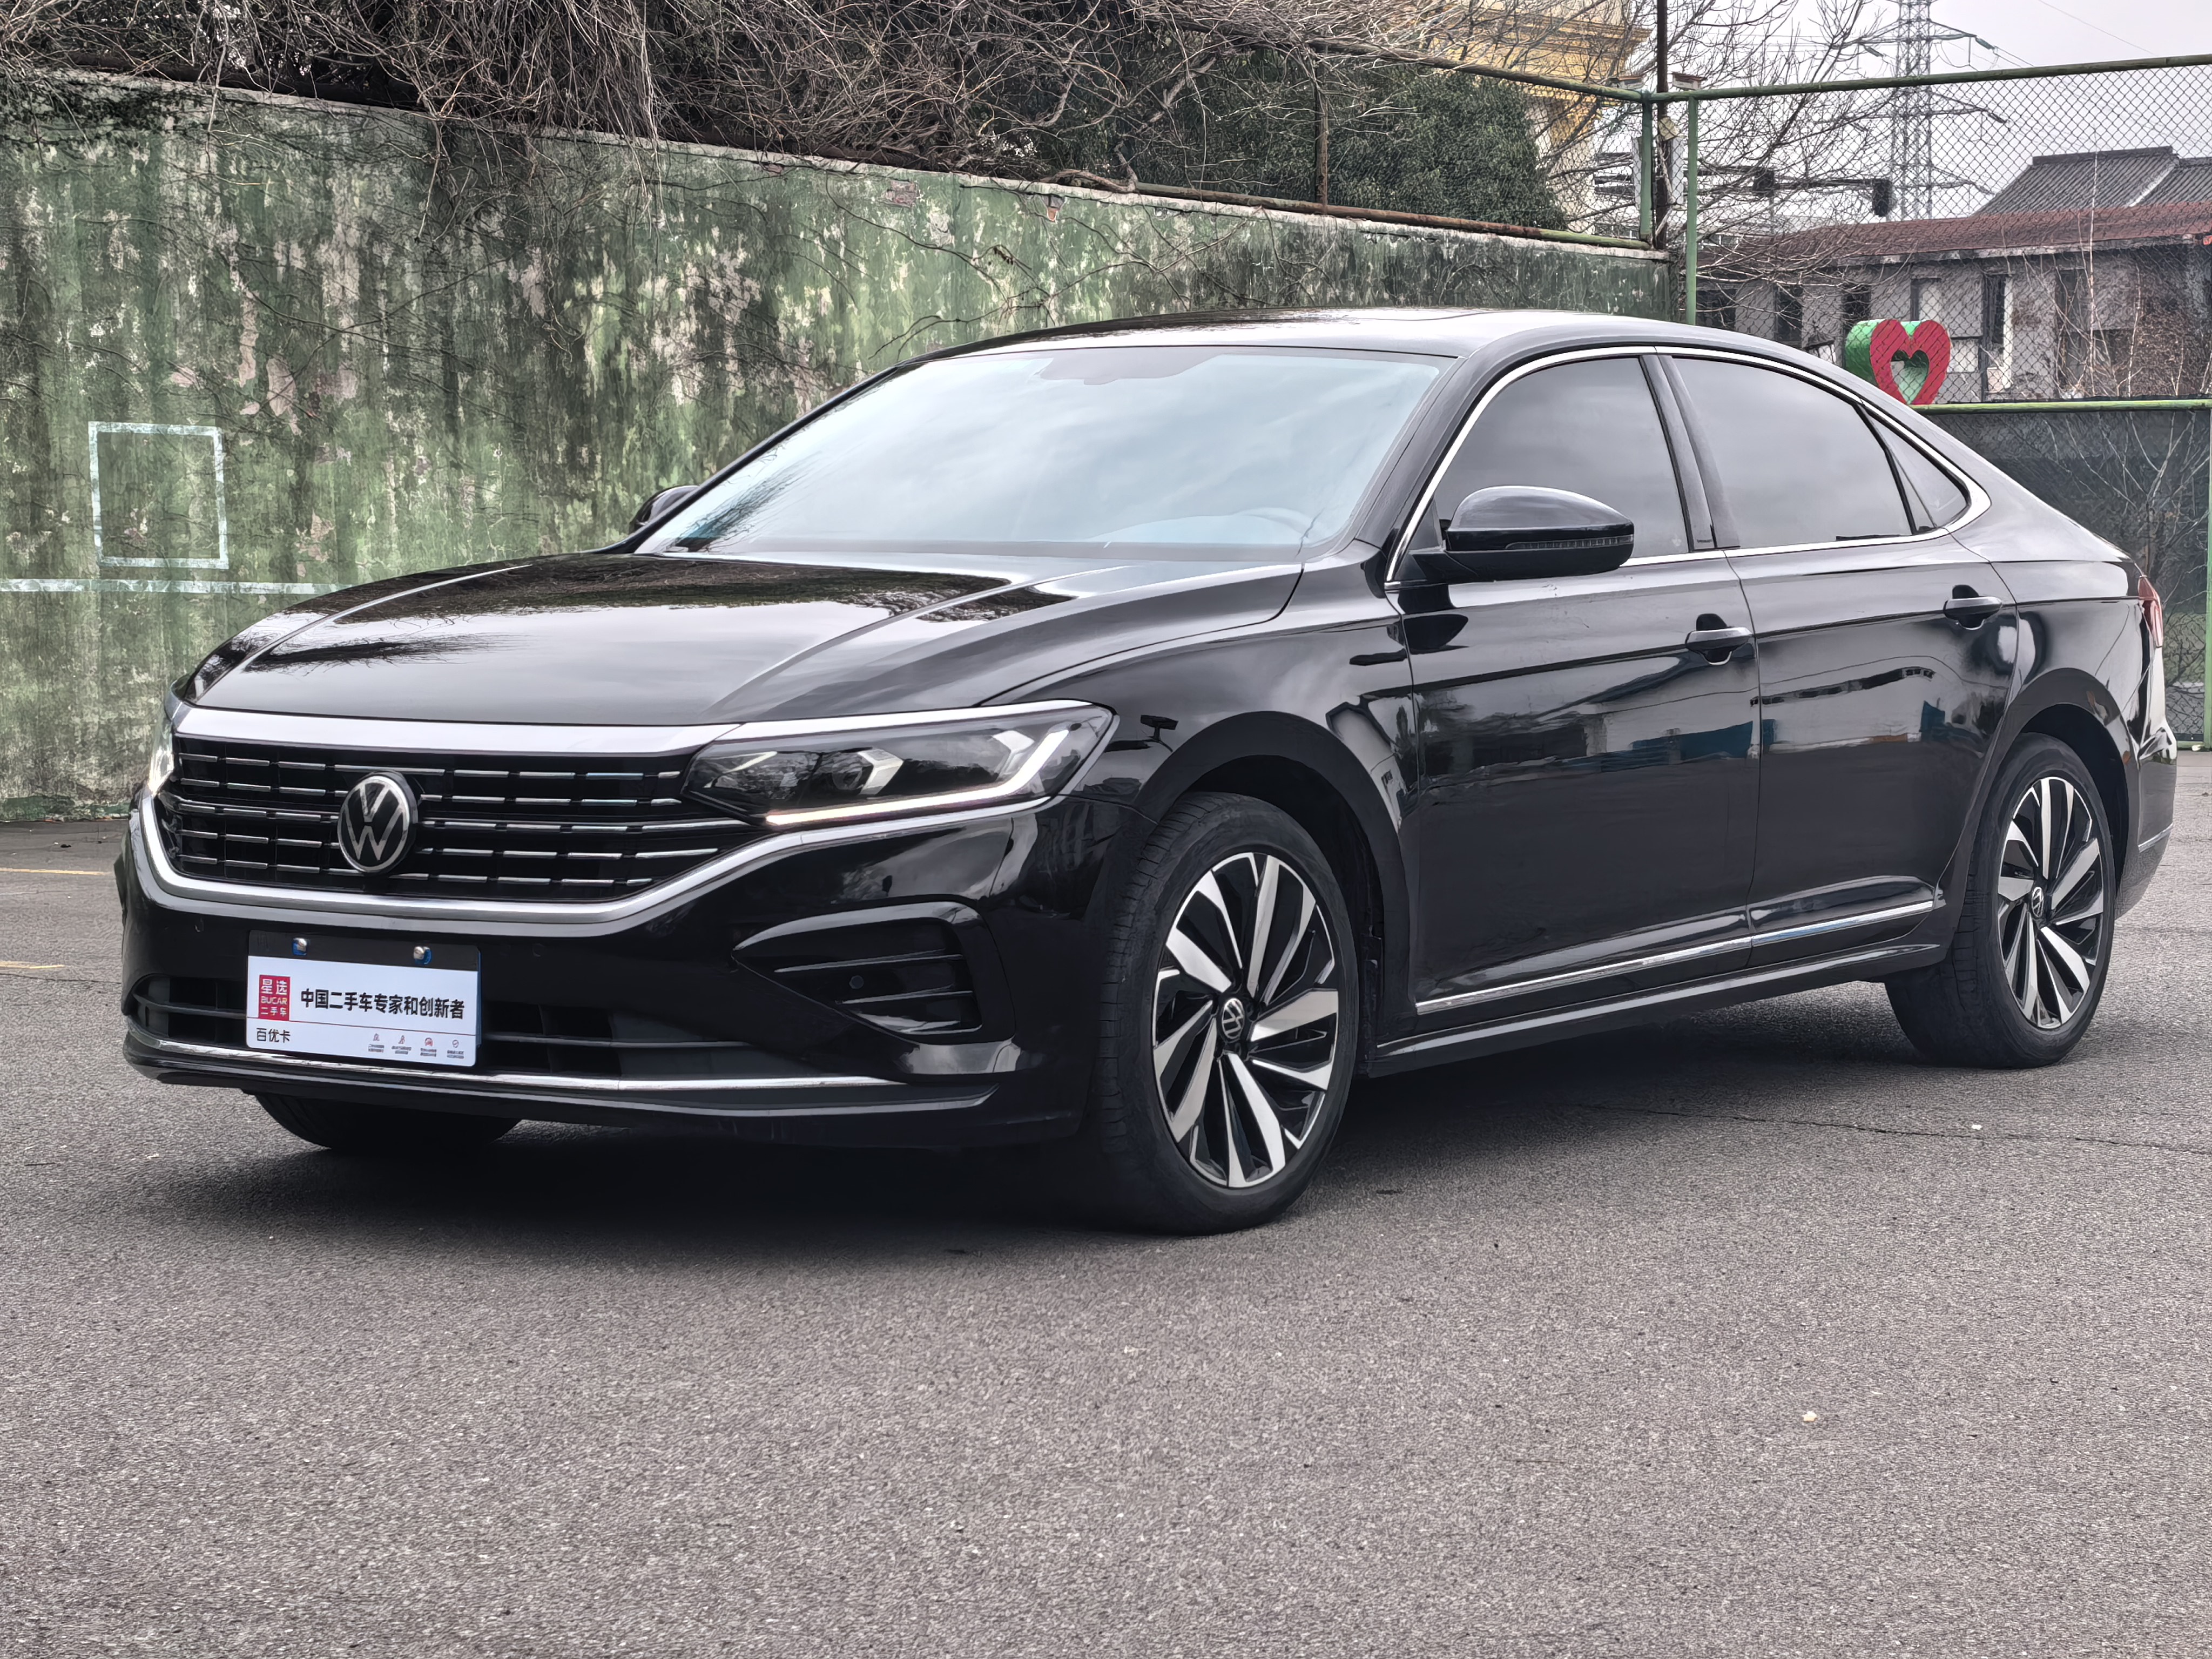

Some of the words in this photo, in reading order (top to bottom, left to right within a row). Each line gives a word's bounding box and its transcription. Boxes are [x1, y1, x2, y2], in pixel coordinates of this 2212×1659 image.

[339, 778, 408, 867] VW
[261, 979, 287, 995] 星选
[261, 996, 287, 1004] BUCAR
[301, 988, 465, 1020] 中国二手车专家和创新者
[260, 1006, 287, 1017] 二手车
[257, 1028, 291, 1043] 百优卡
